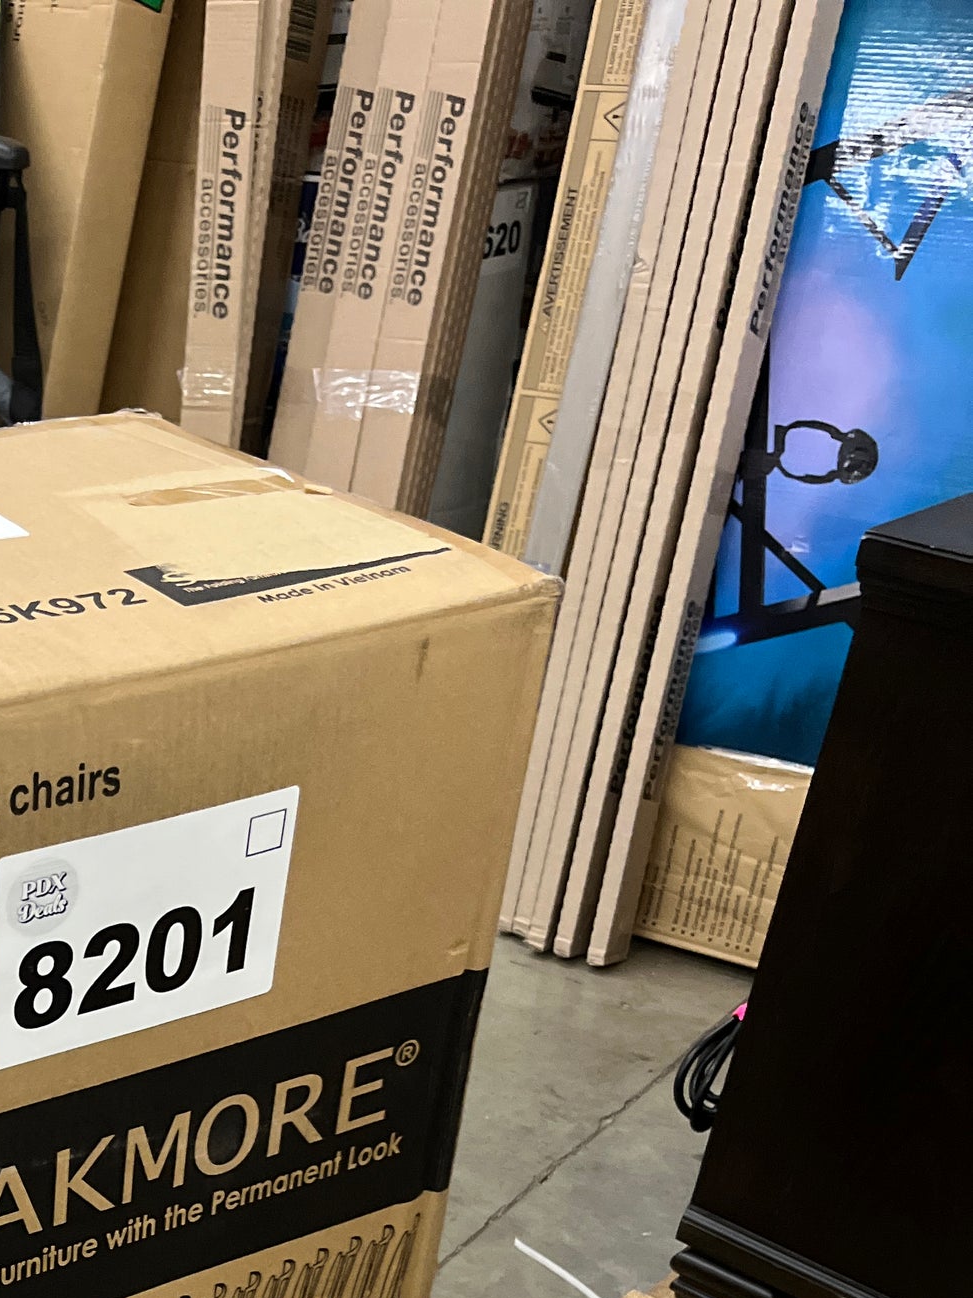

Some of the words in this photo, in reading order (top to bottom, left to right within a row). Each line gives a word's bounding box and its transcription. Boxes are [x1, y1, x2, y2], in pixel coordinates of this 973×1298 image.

[212, 108, 246, 319] Performance
[319, 89, 375, 294] Performance
[357, 90, 415, 299] Performance
[407, 94, 467, 306] Performance
[540, 186, 578, 317] AVERTISSEMENT
[750, 101, 809, 336] Performance
[256, 587, 314, 604] Made
[333, 565, 412, 586] Vietnam
[9, 763, 122, 816] chairs
[16, 893, 69, 925] Deals
[19, 870, 68, 900] PDX
[13, 887, 257, 1030] 8201
[106, 1213, 156, 1251] with
[164, 1203, 205, 1239] the
[211, 1150, 342, 1216] Permanent
[346, 1131, 403, 1171] Look
